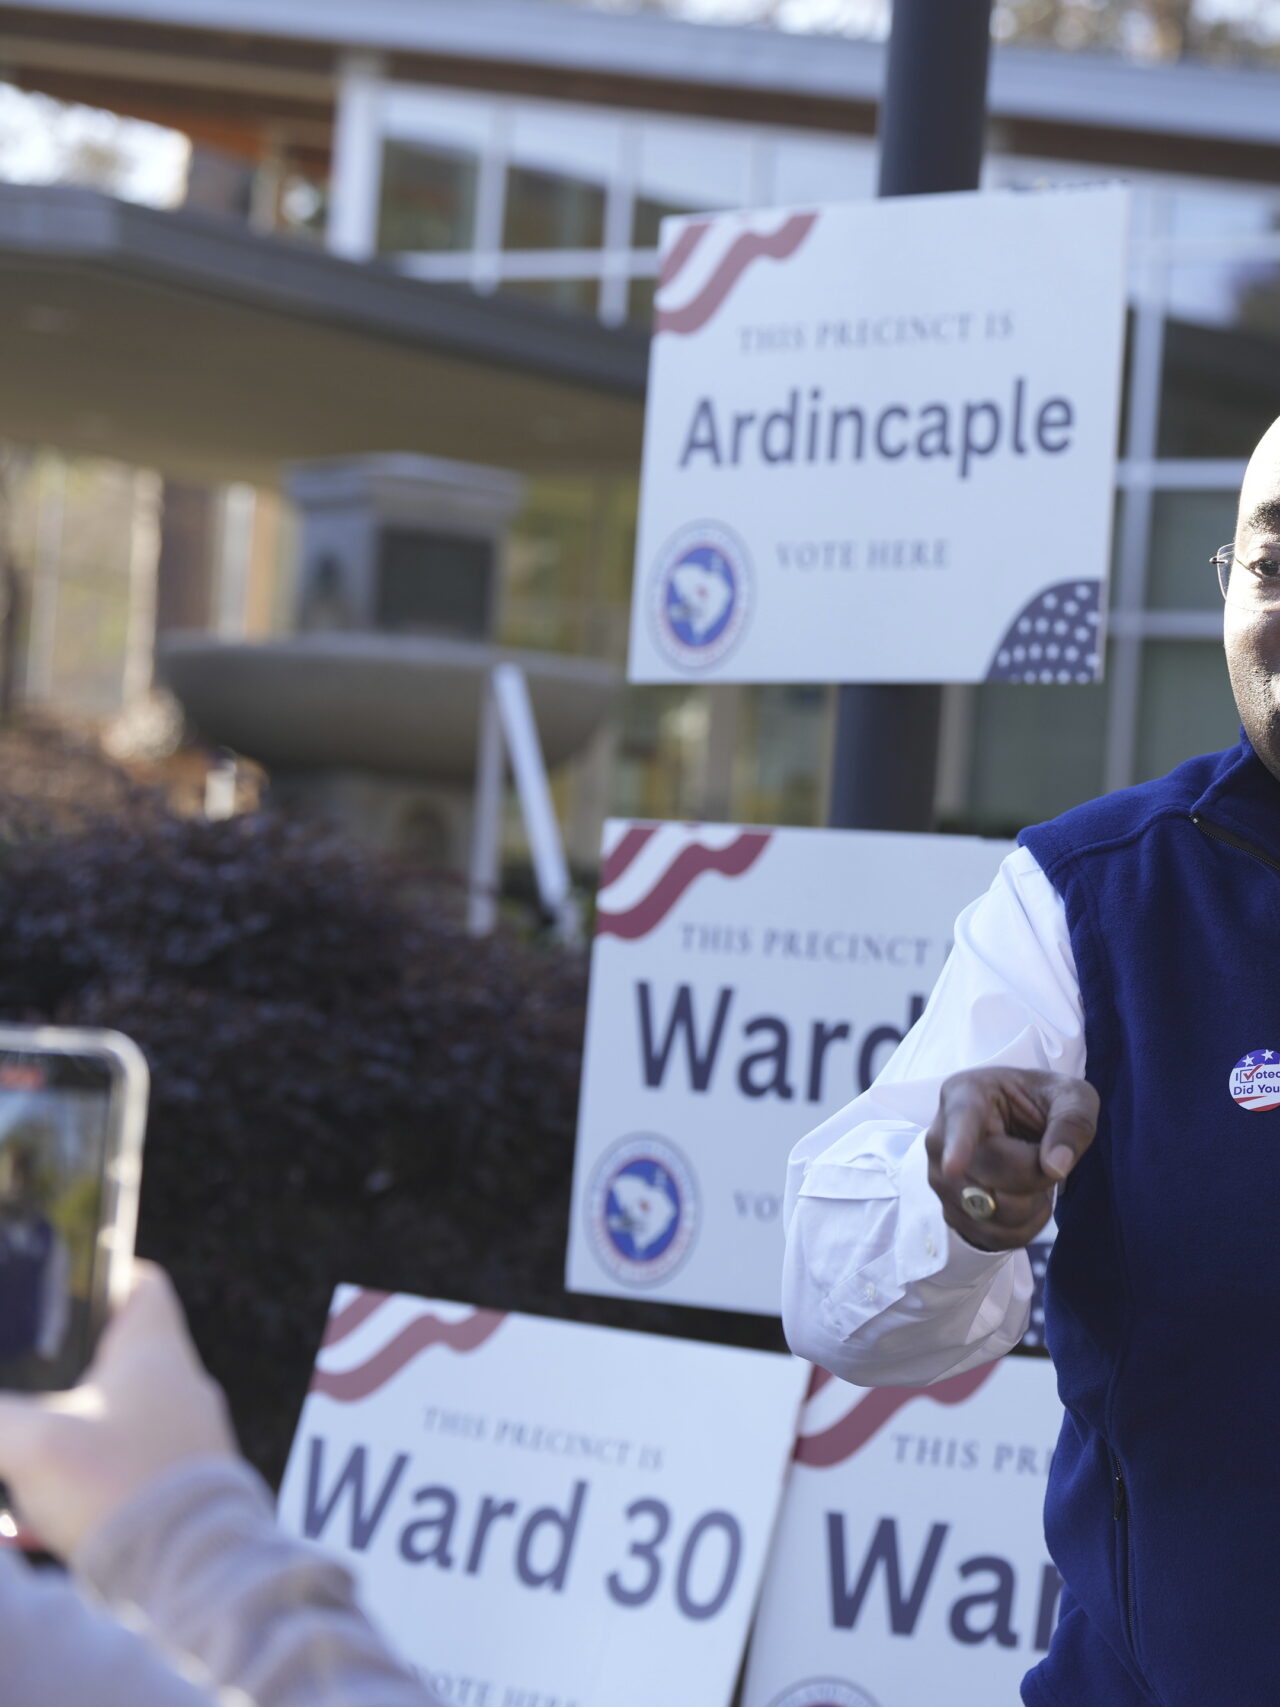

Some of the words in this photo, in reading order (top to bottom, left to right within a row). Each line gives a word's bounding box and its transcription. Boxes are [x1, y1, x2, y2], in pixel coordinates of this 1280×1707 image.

[738, 322, 806, 355] THIS
[815, 311, 972, 350] PRECINCT
[985, 308, 1014, 342] IS
[678, 375, 1075, 482] Ardincaple
[776, 540, 855, 572] VOTE
[866, 538, 951, 571] HERE
[680, 921, 751, 956] THIS
[763, 926, 932, 967] PRECINCT
[1233, 1085, 1254, 1095] Did
[421, 1404, 486, 1442] THIS
[494, 1417, 633, 1468] PRECINCT
[638, 1444, 664, 1474] IS
[890, 1433, 979, 1471] THIS
[300, 1434, 590, 1594] Ward
[604, 1495, 743, 1623] 30
